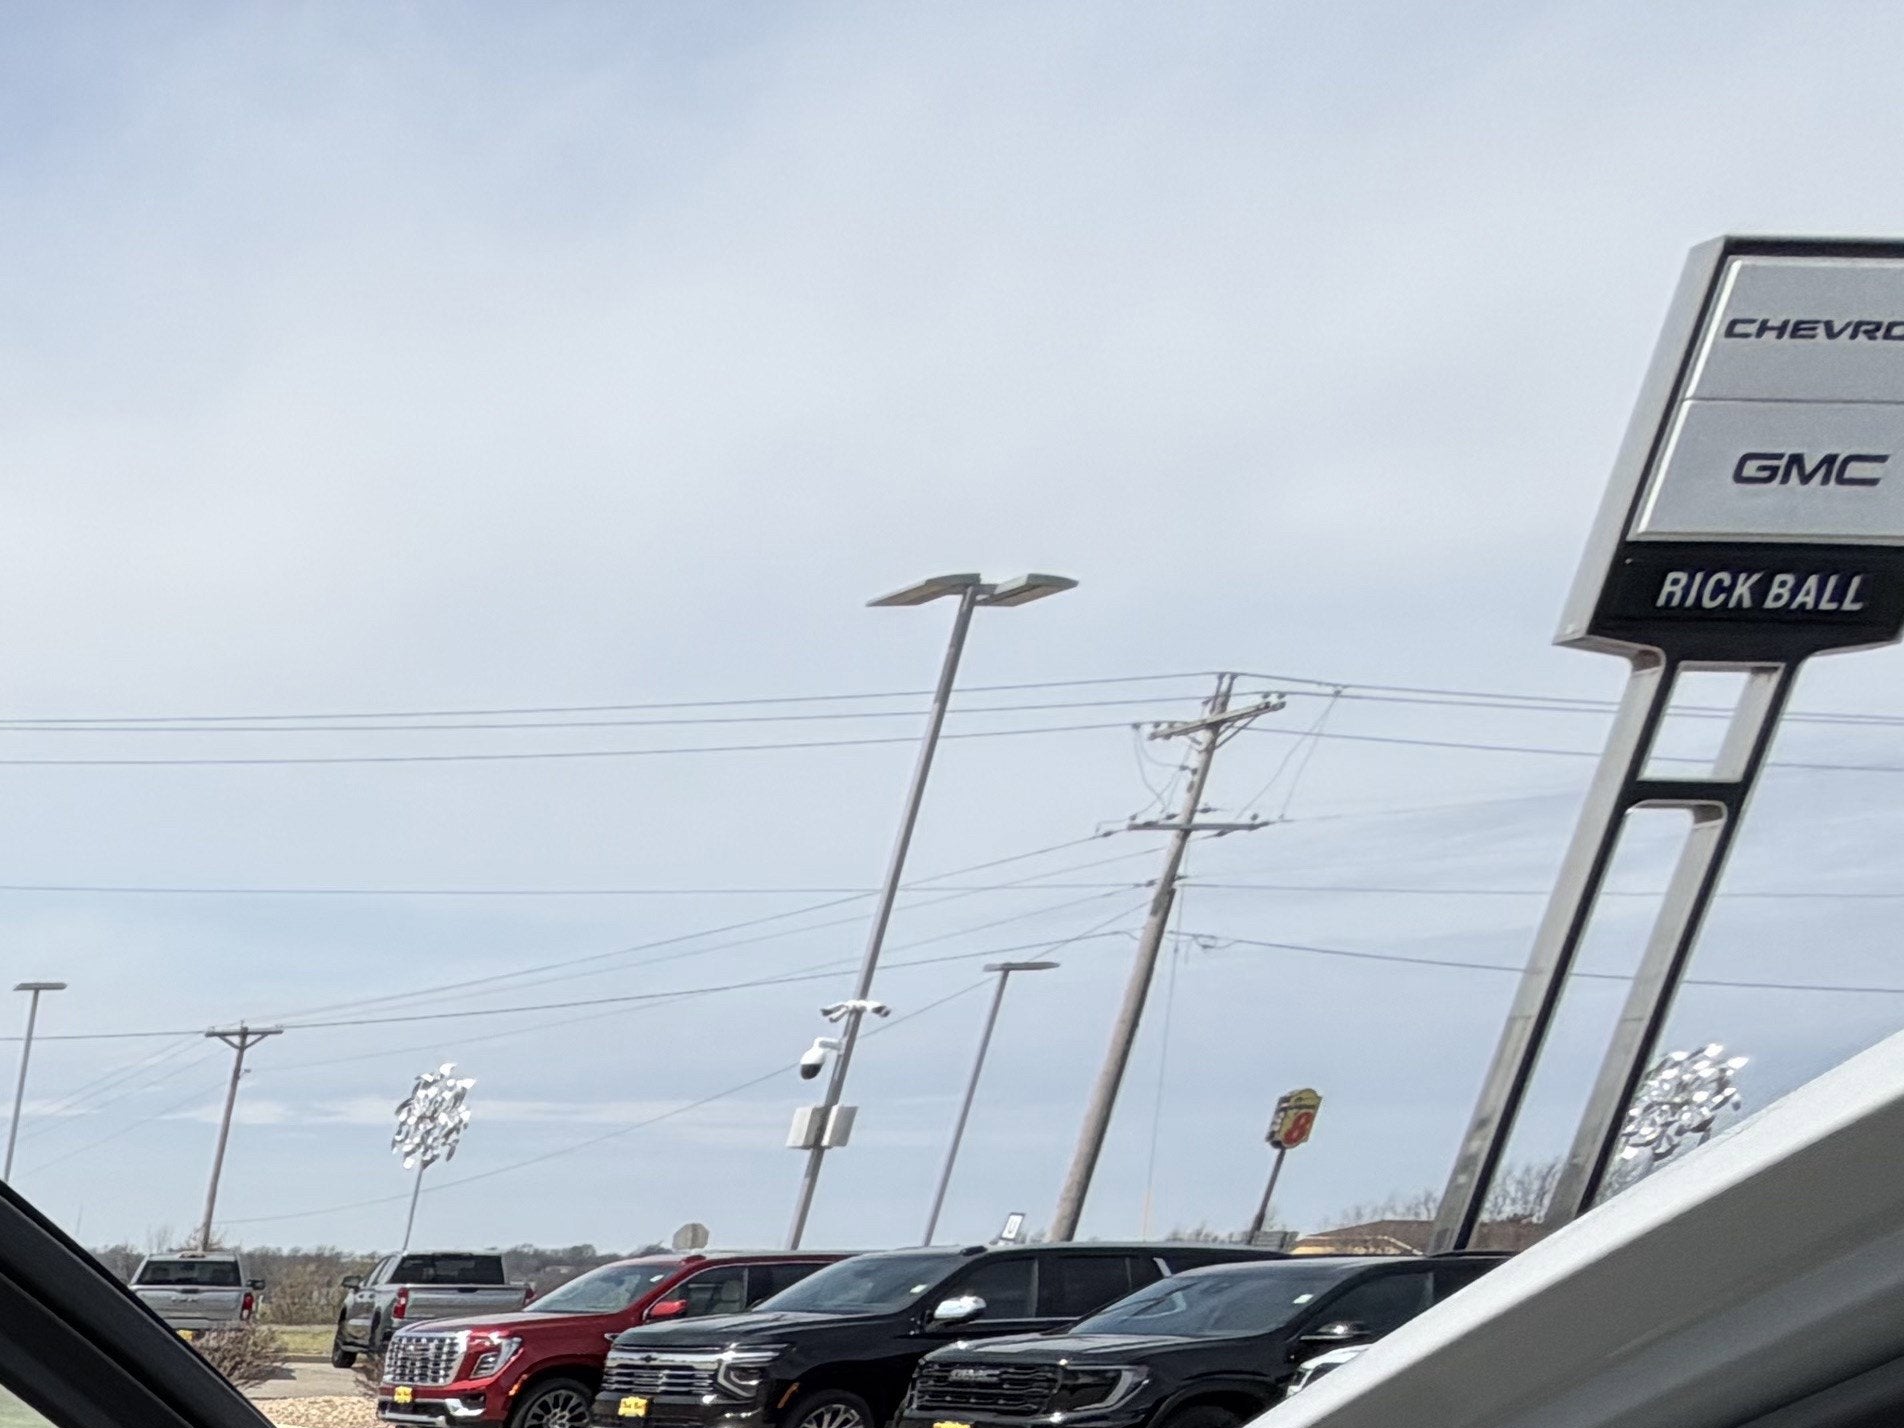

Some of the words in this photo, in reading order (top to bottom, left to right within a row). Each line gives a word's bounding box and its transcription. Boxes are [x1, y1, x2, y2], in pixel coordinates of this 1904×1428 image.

[1731, 451, 1891, 488] GMC
[1655, 569, 1764, 611] RICK
[1763, 571, 1867, 613] BALL
